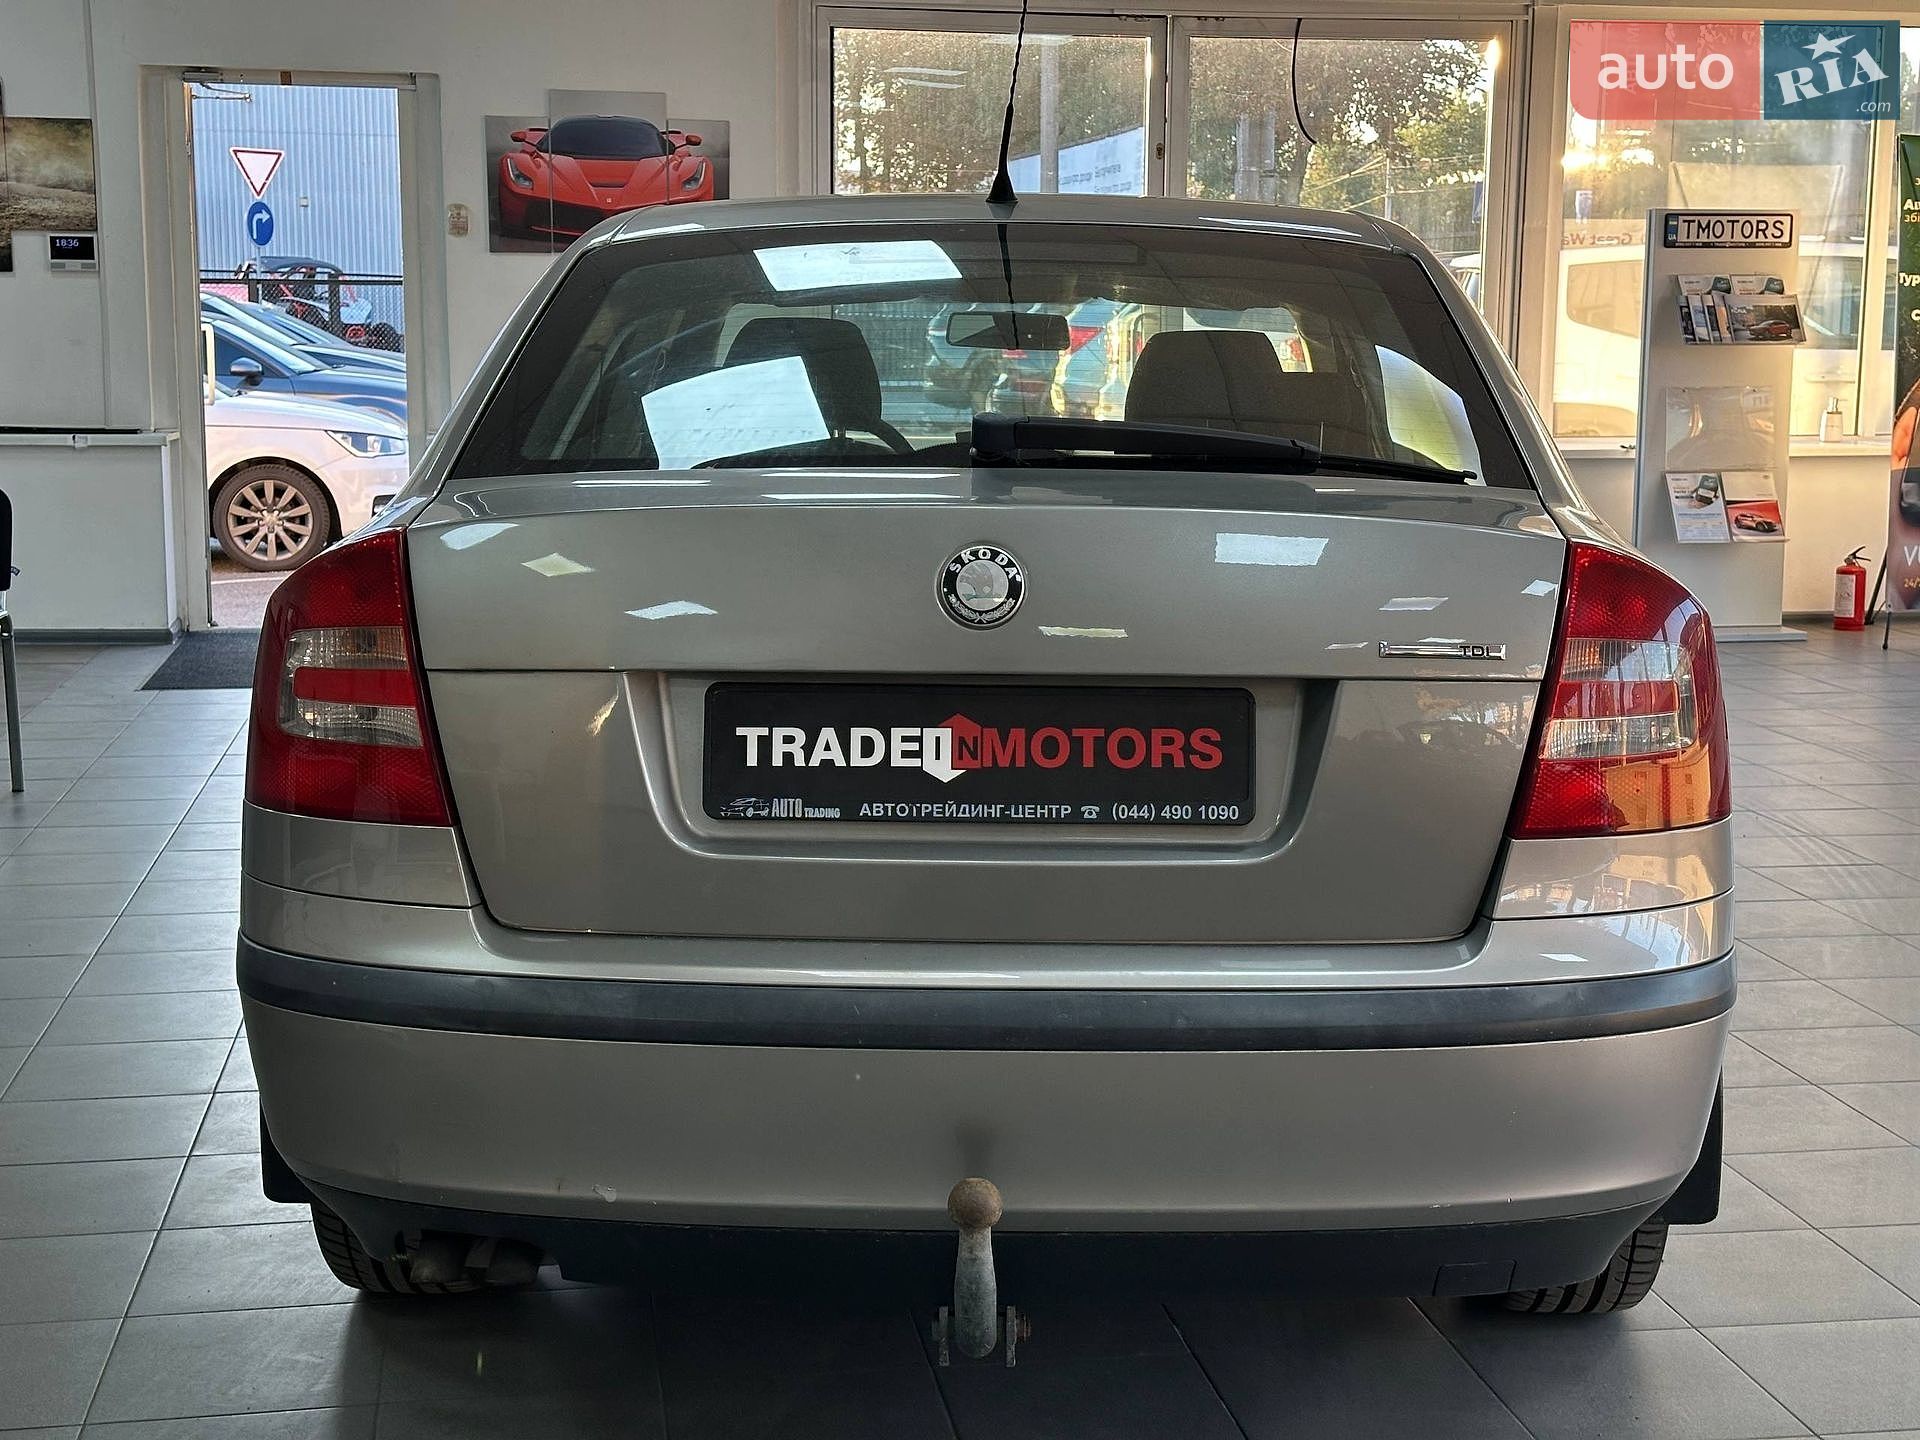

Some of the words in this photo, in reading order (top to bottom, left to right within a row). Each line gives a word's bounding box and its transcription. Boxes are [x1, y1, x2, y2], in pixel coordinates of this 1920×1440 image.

[1682, 219, 1785, 240] TMOTORS
[948, 548, 1019, 580] SKODA
[1459, 645, 1490, 657] TDI
[771, 797, 803, 818] AUTO
[803, 806, 841, 819] TRADING
[1111, 802, 1156, 822] (044)
[1160, 804, 1193, 821] 490
[1198, 804, 1240, 821] 1090
